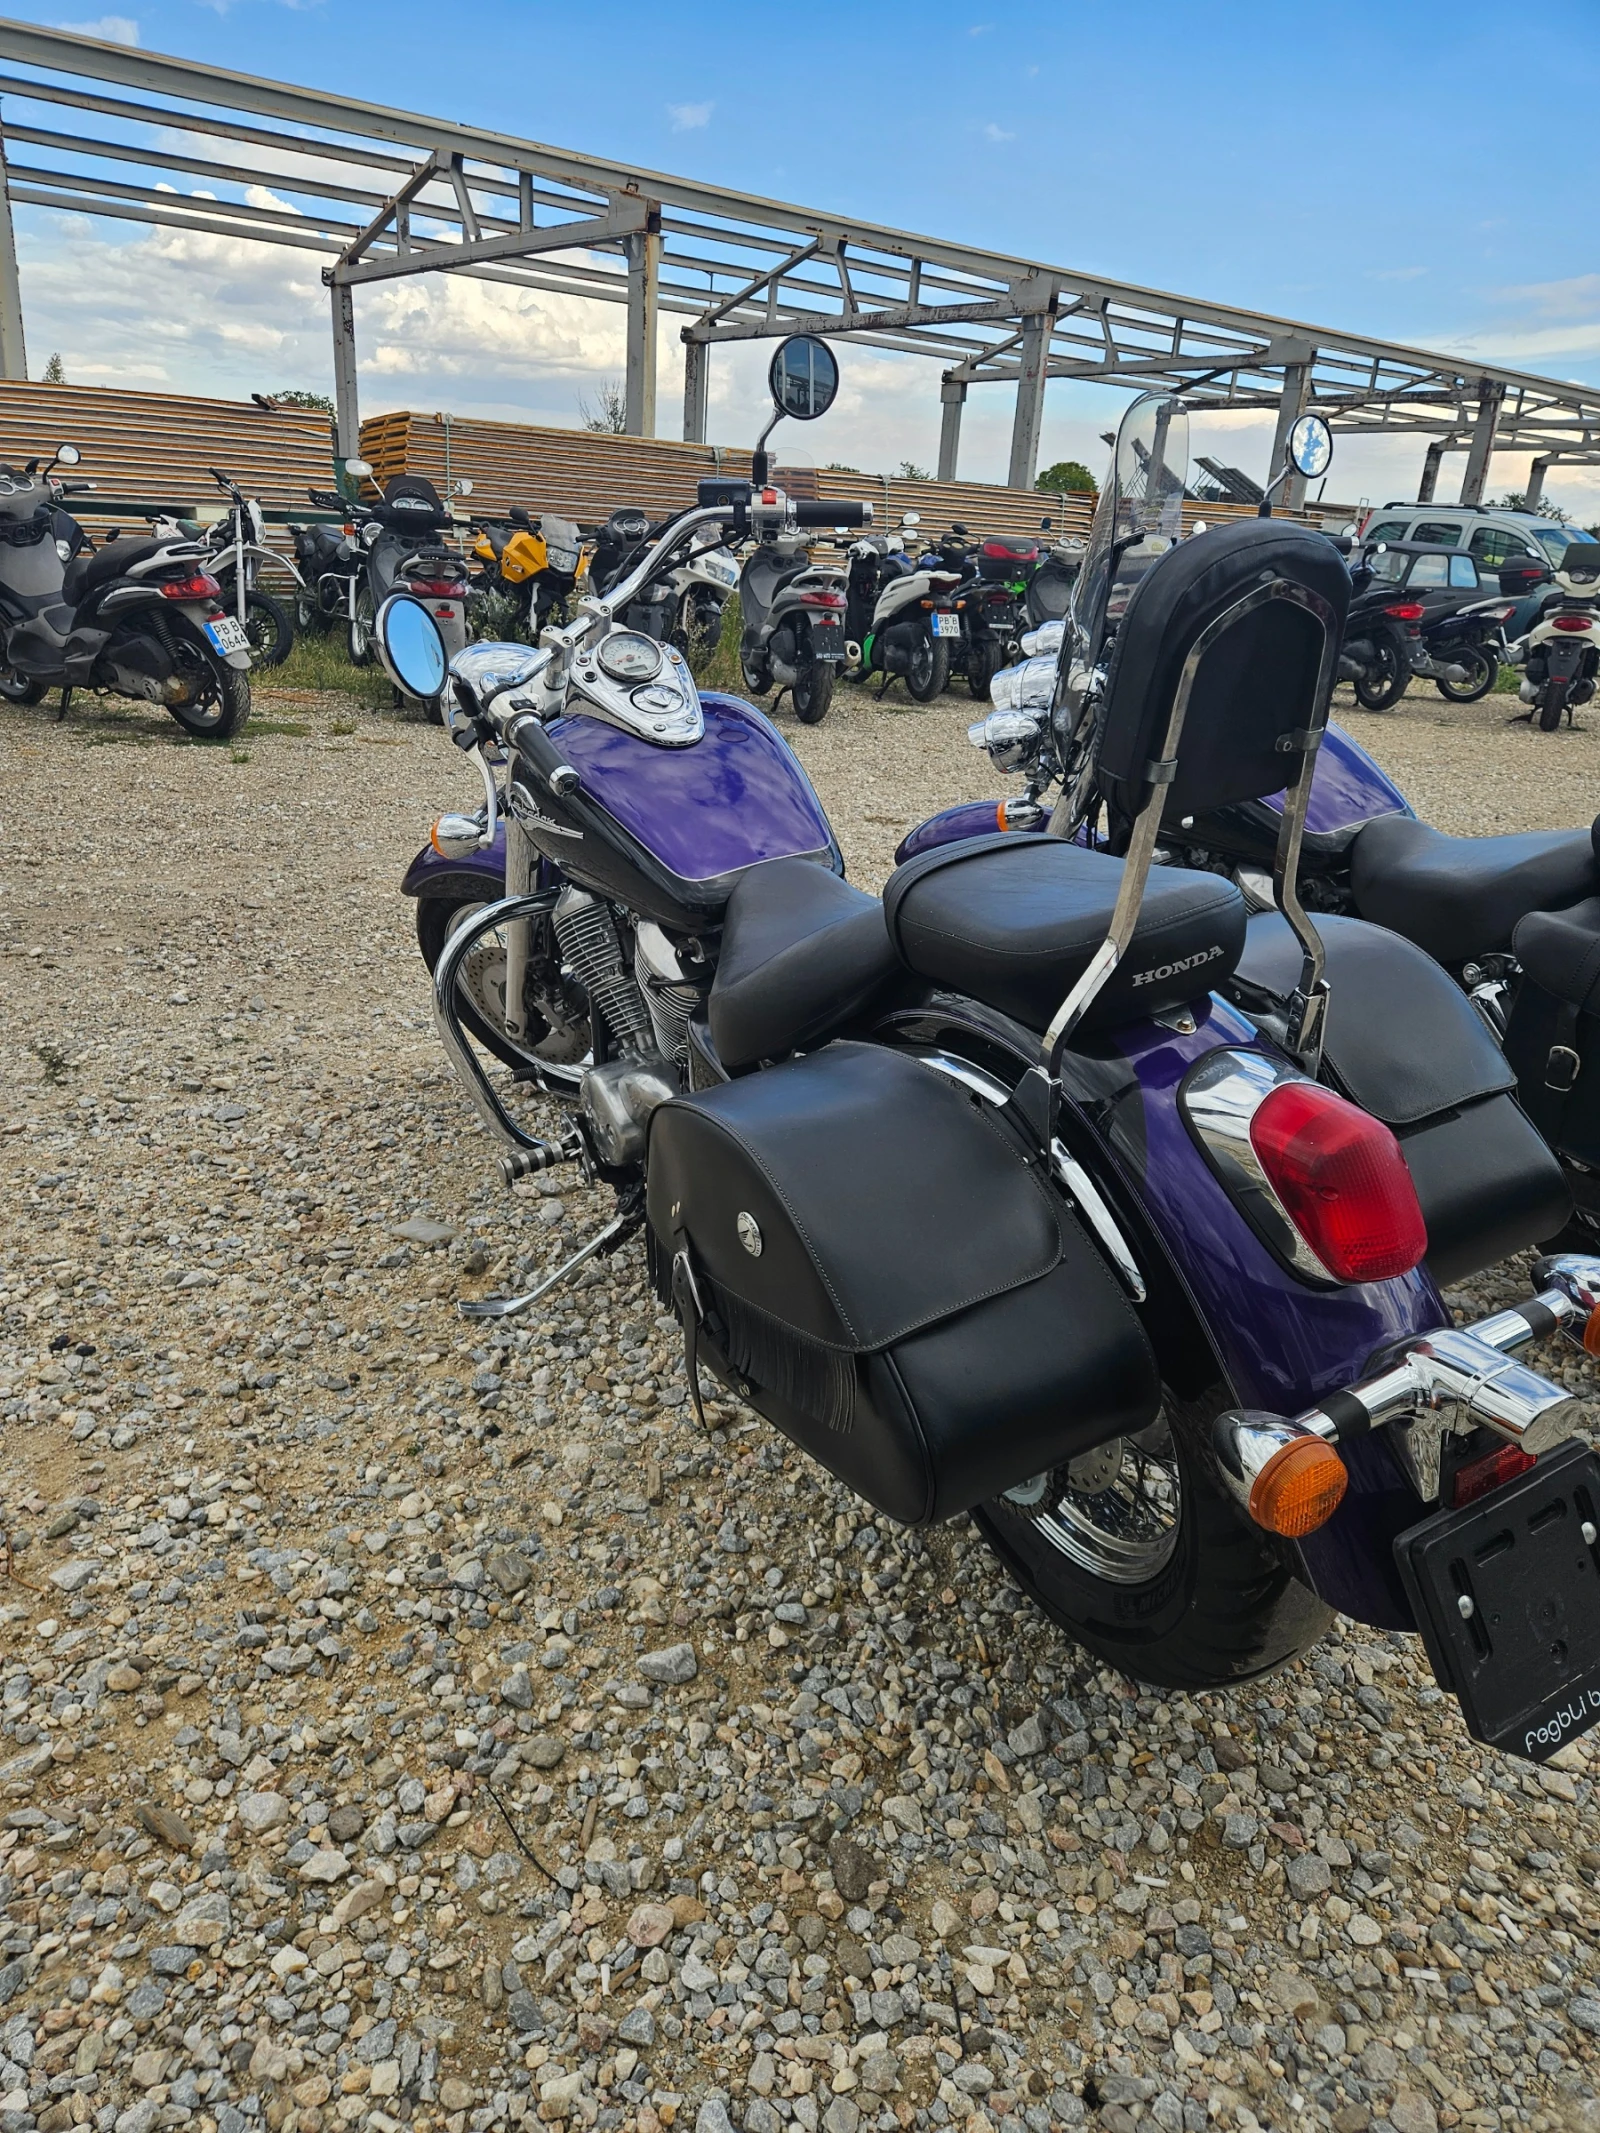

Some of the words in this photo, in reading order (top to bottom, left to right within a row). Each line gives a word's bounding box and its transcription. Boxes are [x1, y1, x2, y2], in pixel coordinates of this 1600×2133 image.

[213, 623, 230, 637] PB
[230, 620, 240, 632] B
[939, 616, 949, 625] PB
[952, 616, 958, 625] B
[939, 626, 959, 634] 3970
[221, 633, 247, 650] 0644
[1132, 945, 1225, 987] HONDA
